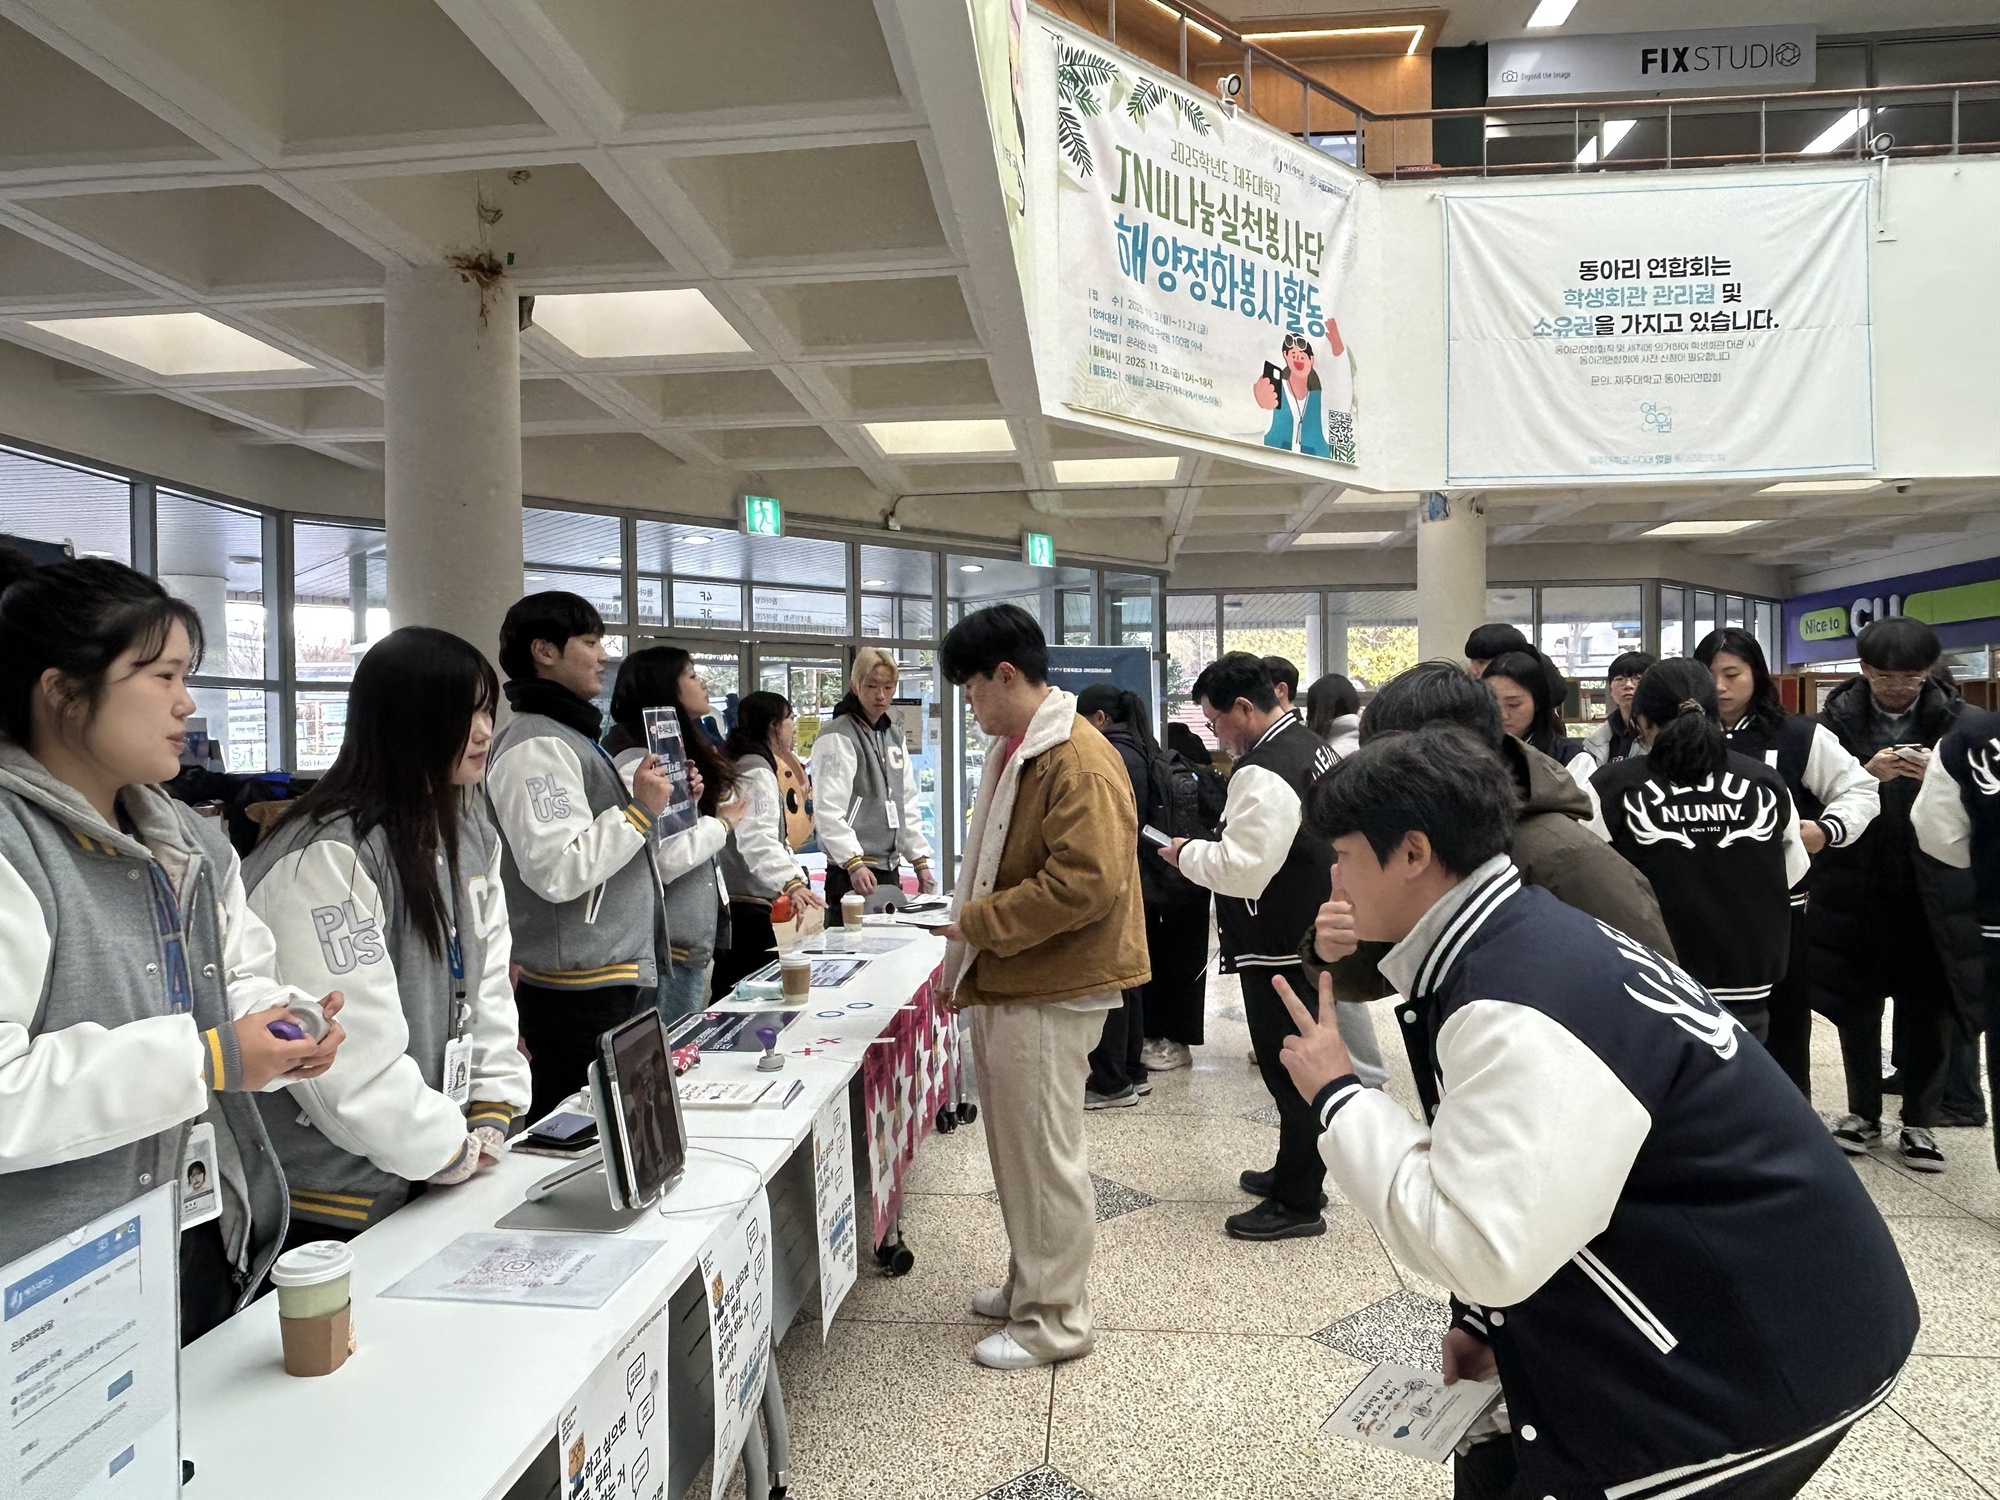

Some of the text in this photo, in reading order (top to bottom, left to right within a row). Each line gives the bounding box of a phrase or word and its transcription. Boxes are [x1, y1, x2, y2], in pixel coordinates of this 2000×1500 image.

[1170, 139, 1229, 185] 2025학년도
[1232, 164, 1282, 206] 제주대학교
[1111, 144, 1325, 278] JNU나눔실천봉사단
[1113, 212, 1326, 338] 해양정화봉사활동
[1578, 256, 1732, 282] 동아리 연합회는
[1563, 283, 1742, 309] 학생회관 관리권 및
[1533, 309, 1780, 337] 소유권을 가지고 있습니다.
[1640, 354, 1659, 363] 사전
[1660, 353, 1686, 363] 신청이
[1654, 341, 1688, 352] 의거하여
[1614, 374, 1662, 385] 제주대학교
[1664, 373, 1722, 384] 동아리연합회
[1805, 617, 1827, 635] Nice
[1828, 618, 1840, 631] to
[887, 746, 903, 769] C
[1661, 803, 1746, 823] N.UNIV.
[585, 1446, 602, 1479] 하고
[602, 1411, 627, 1457] 싶으면
[595, 1457, 612, 1493] 부터
[617, 1463, 626, 1488] 거
